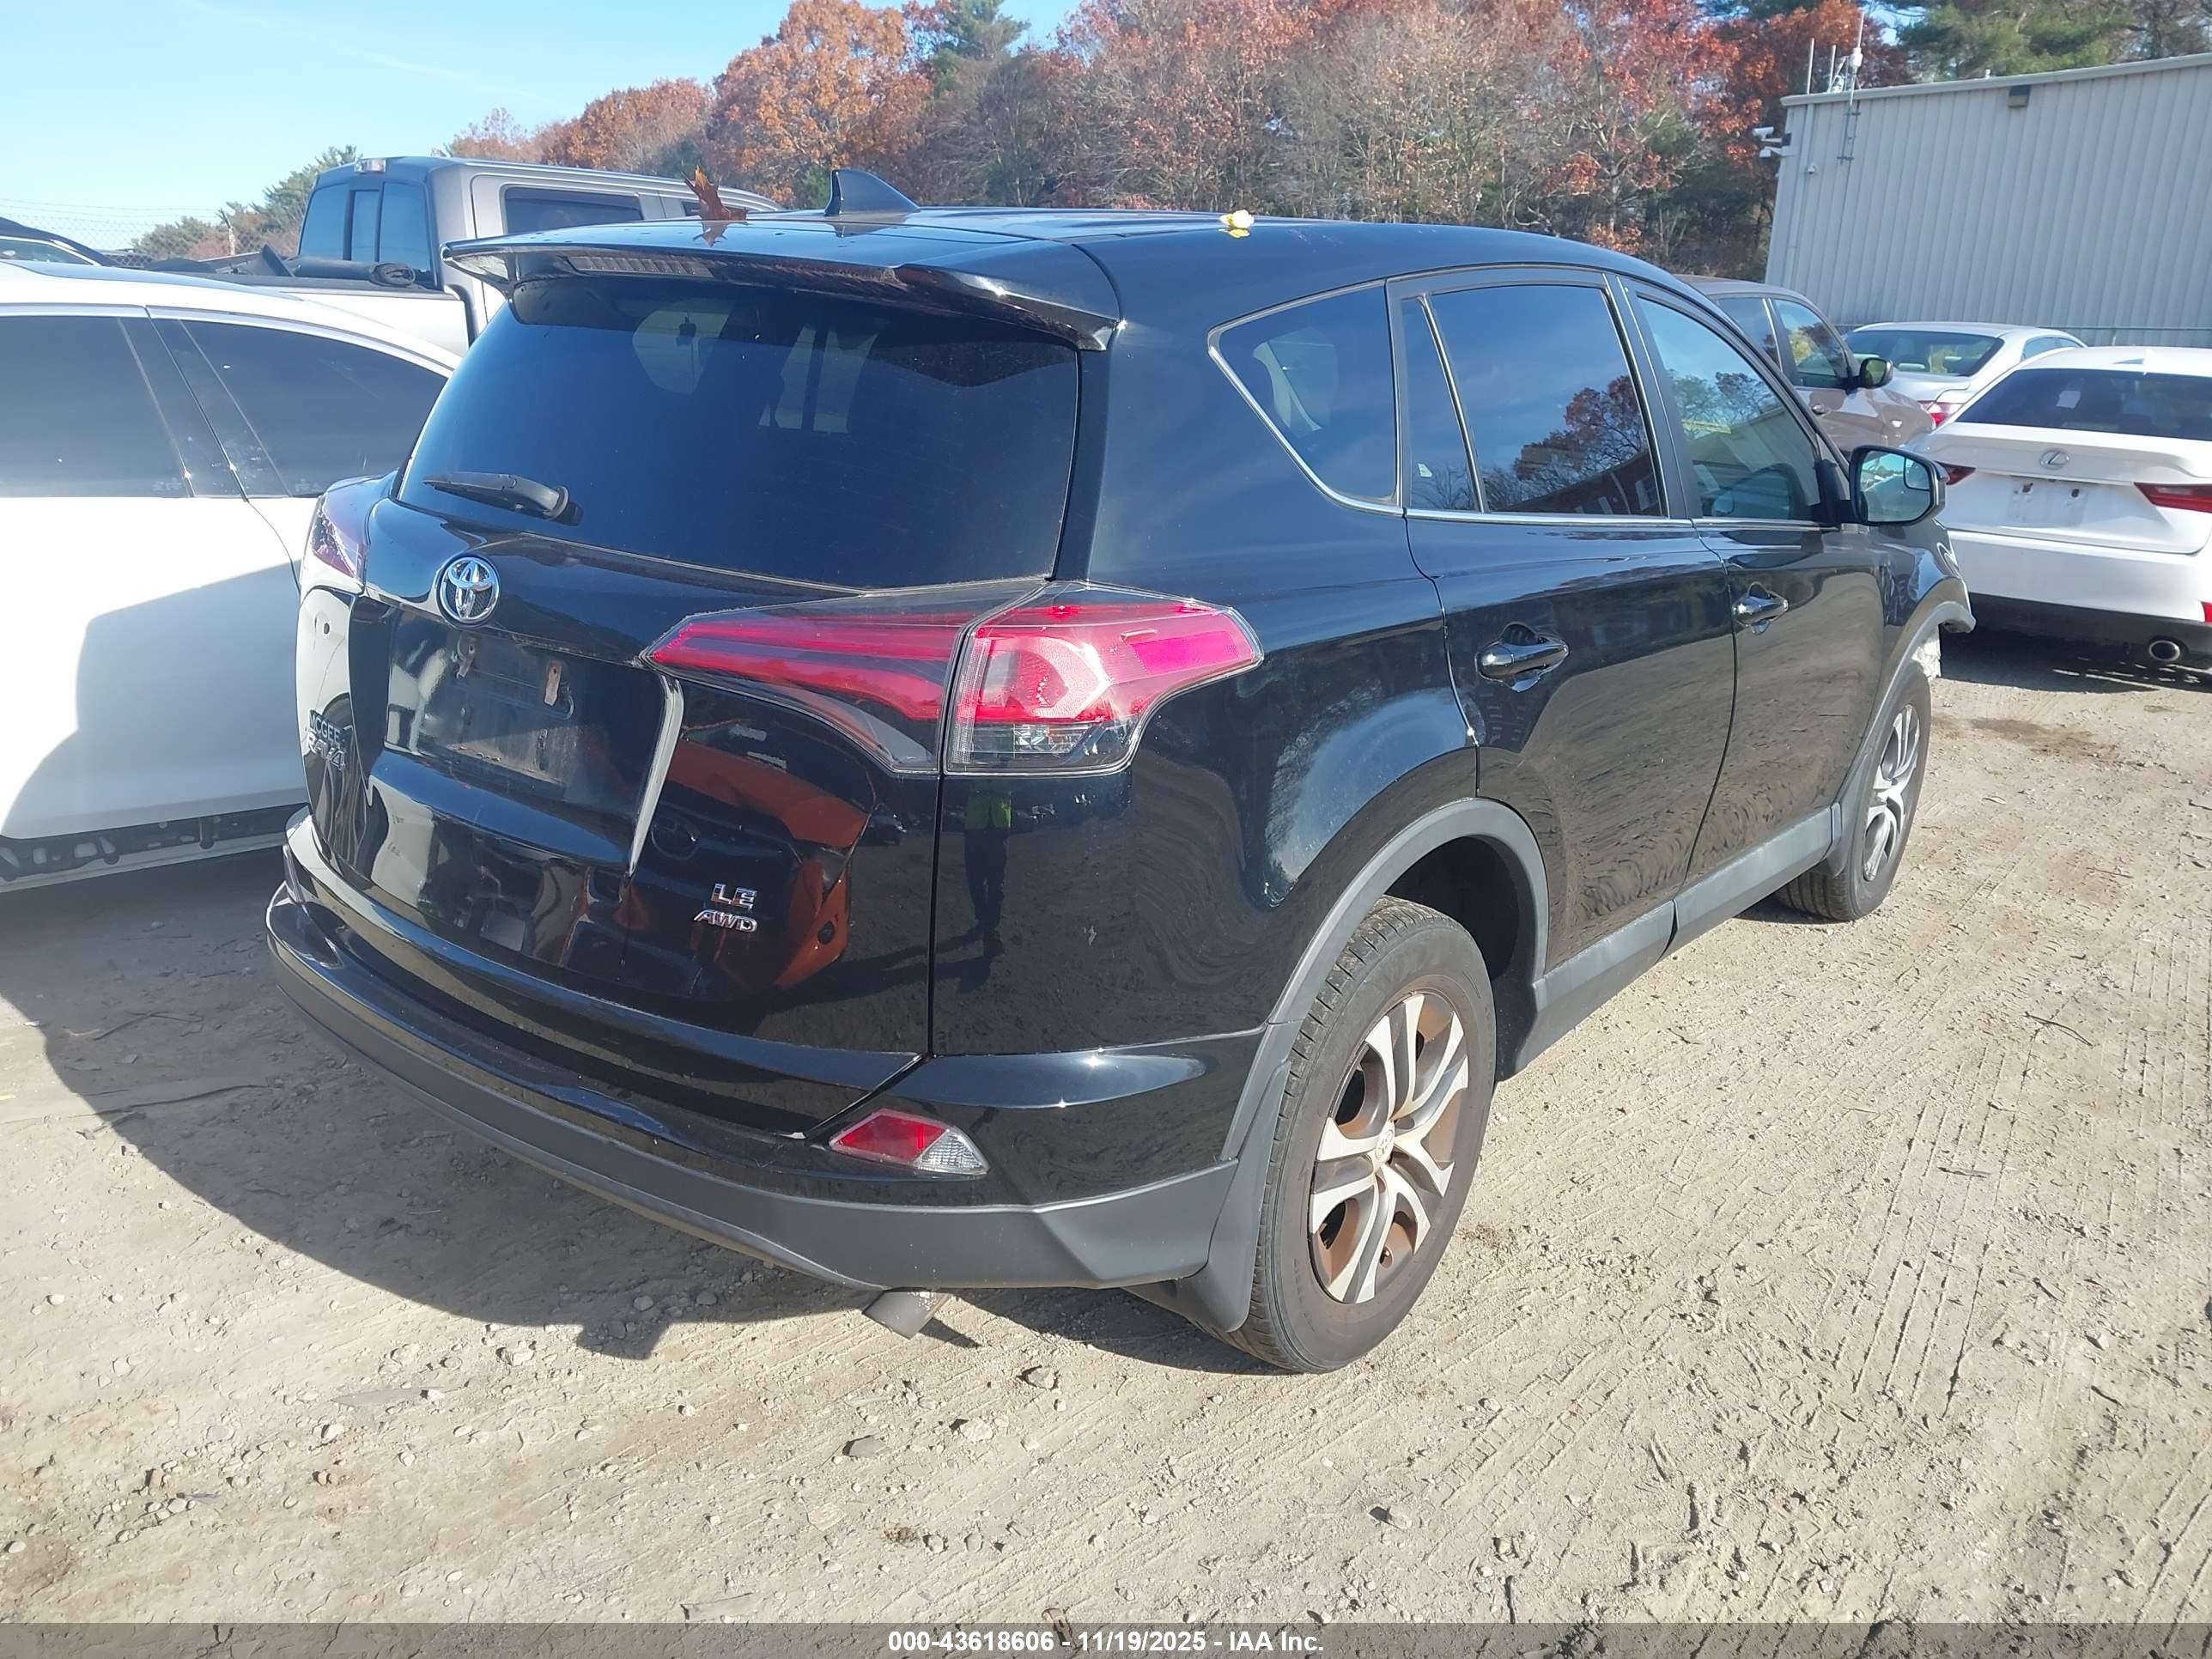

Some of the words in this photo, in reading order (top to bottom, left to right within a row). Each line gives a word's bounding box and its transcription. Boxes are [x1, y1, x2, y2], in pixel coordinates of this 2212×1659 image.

[309, 712, 341, 744] MCGEE
[711, 883, 757, 909] LE
[694, 909, 757, 932] AWD
